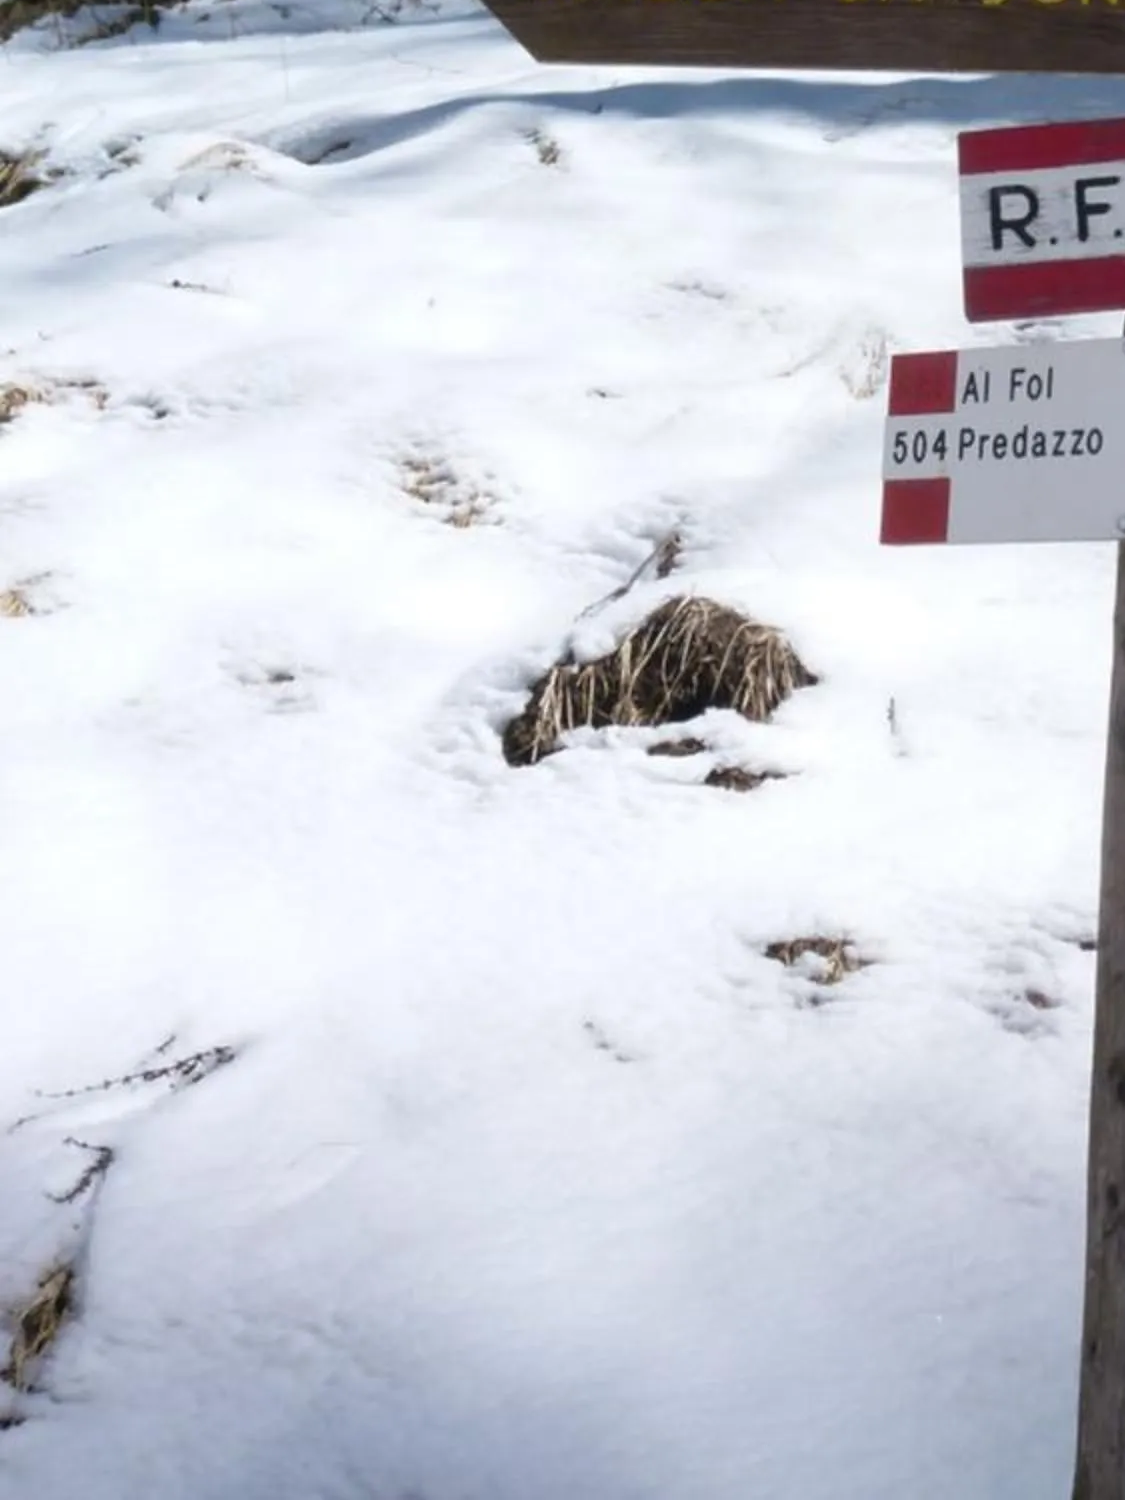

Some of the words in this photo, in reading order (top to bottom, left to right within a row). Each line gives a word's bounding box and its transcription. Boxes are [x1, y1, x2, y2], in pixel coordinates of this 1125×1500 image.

[961, 370, 990, 404] Al
[1009, 366, 1054, 401] Fol
[892, 430, 948, 464] 504
[957, 425, 1104, 461] Predazzo
